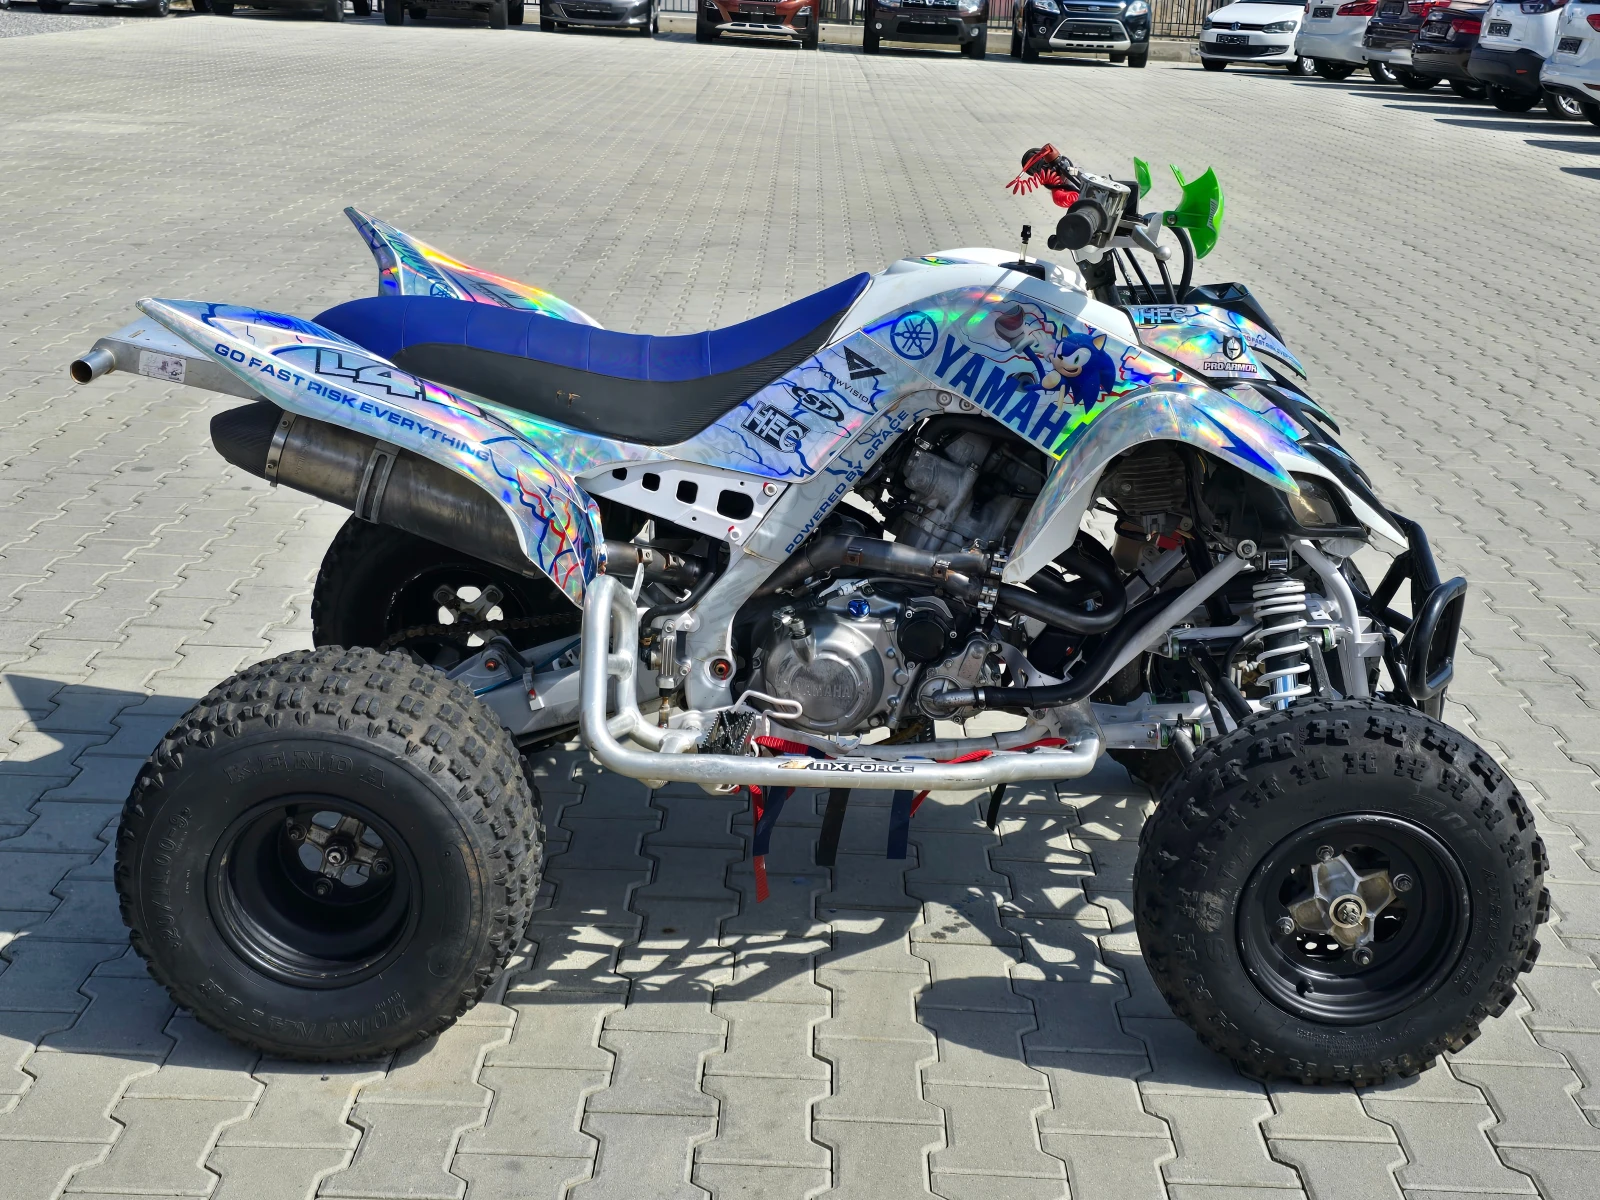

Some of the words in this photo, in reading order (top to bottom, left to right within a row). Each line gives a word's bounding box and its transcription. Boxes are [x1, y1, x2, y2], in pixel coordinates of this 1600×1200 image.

[214, 343, 246, 363] GO
[248, 356, 305, 386] FAST
[307, 381, 357, 408] RISK
[360, 401, 490, 462] EVERYTHING
[1203, 361, 1225, 371] PRO
[1224, 363, 1258, 373] ARMOR
[784, 482, 847, 554] POWERED
[845, 460, 863, 483] BY
[863, 410, 909, 460] GRACE
[222, 750, 386, 791] KENDA
